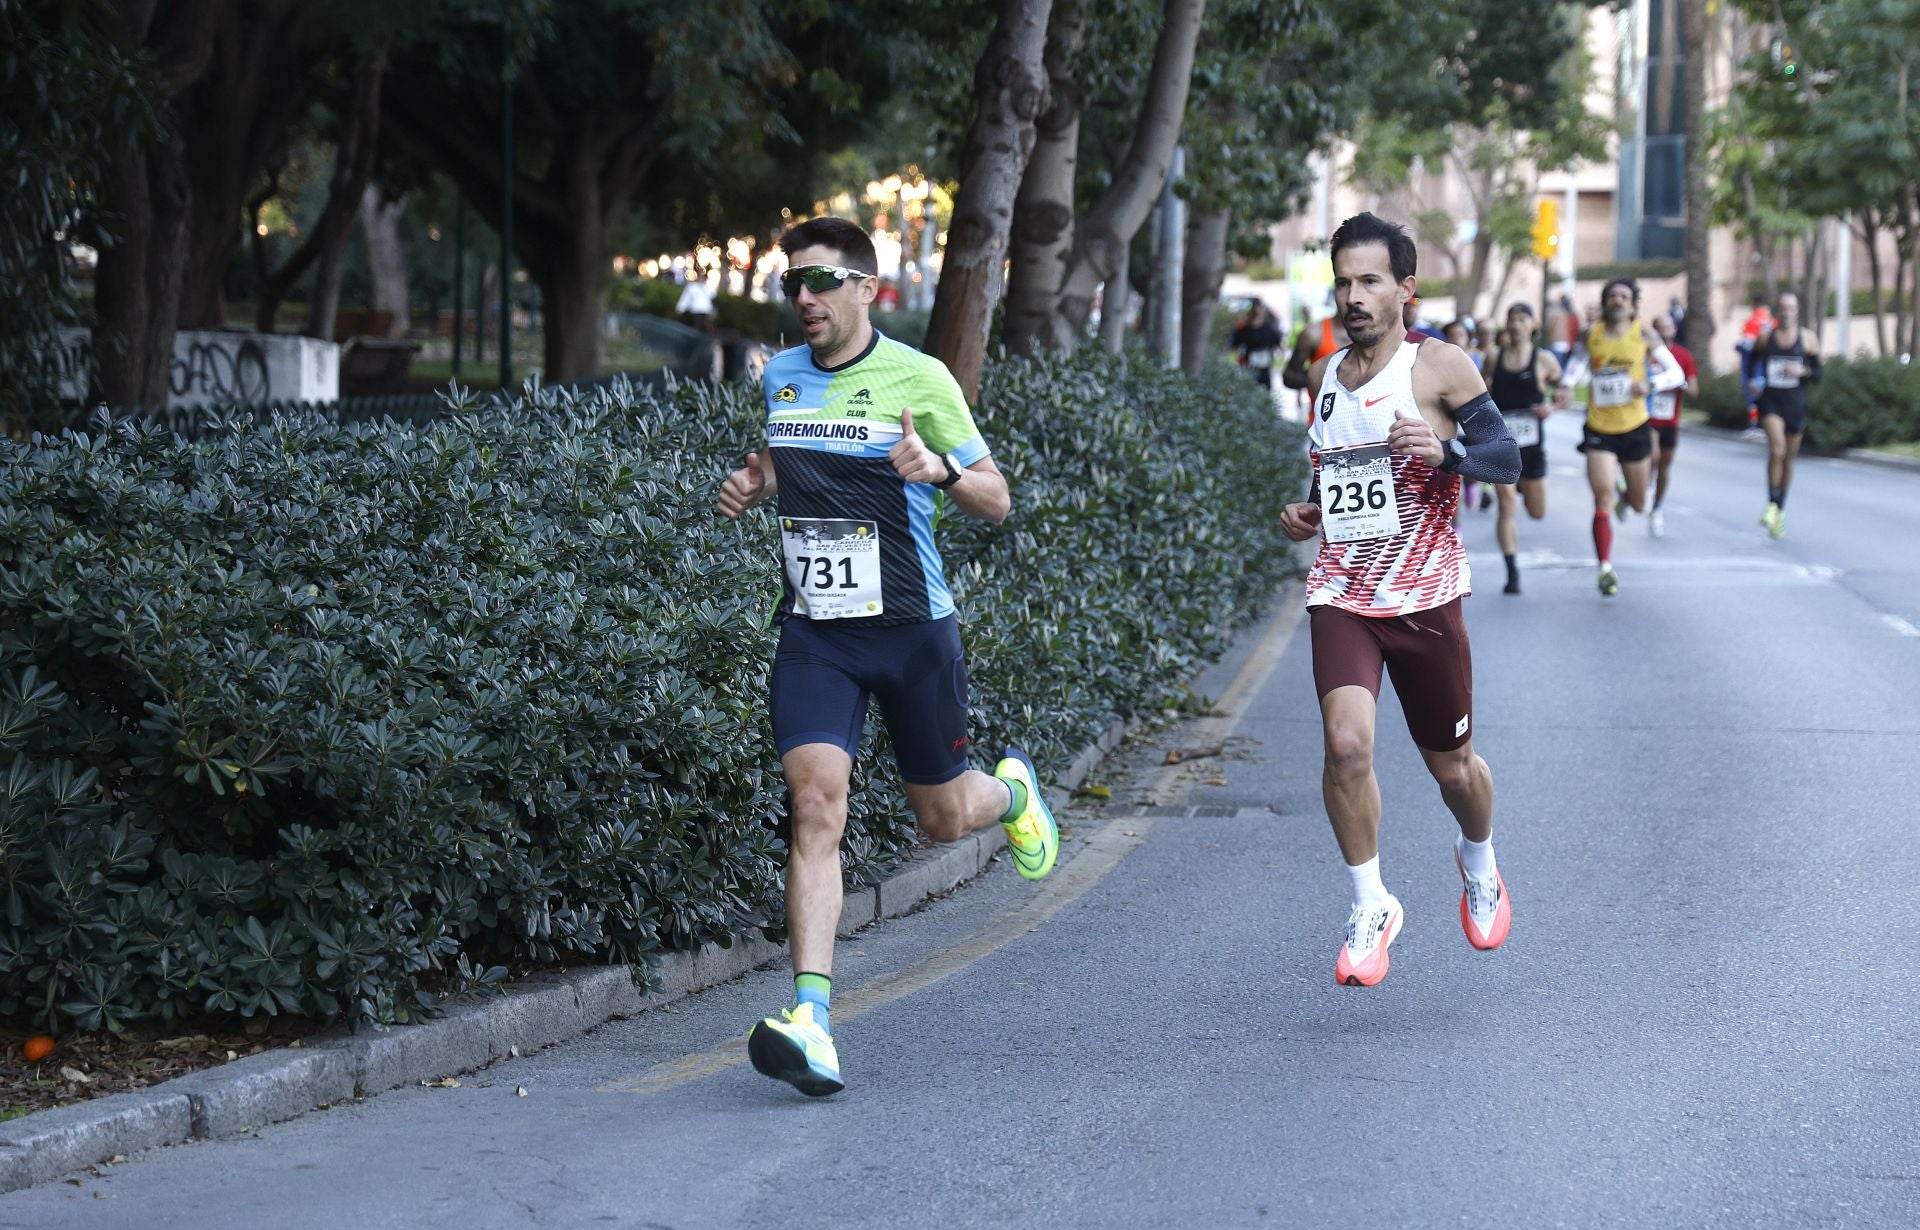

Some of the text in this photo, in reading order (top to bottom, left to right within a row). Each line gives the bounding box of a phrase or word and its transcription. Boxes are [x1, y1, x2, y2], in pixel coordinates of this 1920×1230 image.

[846, 410, 867, 418] CLUB
[1328, 479, 1387, 514] 236
[797, 556, 858, 589] 731
